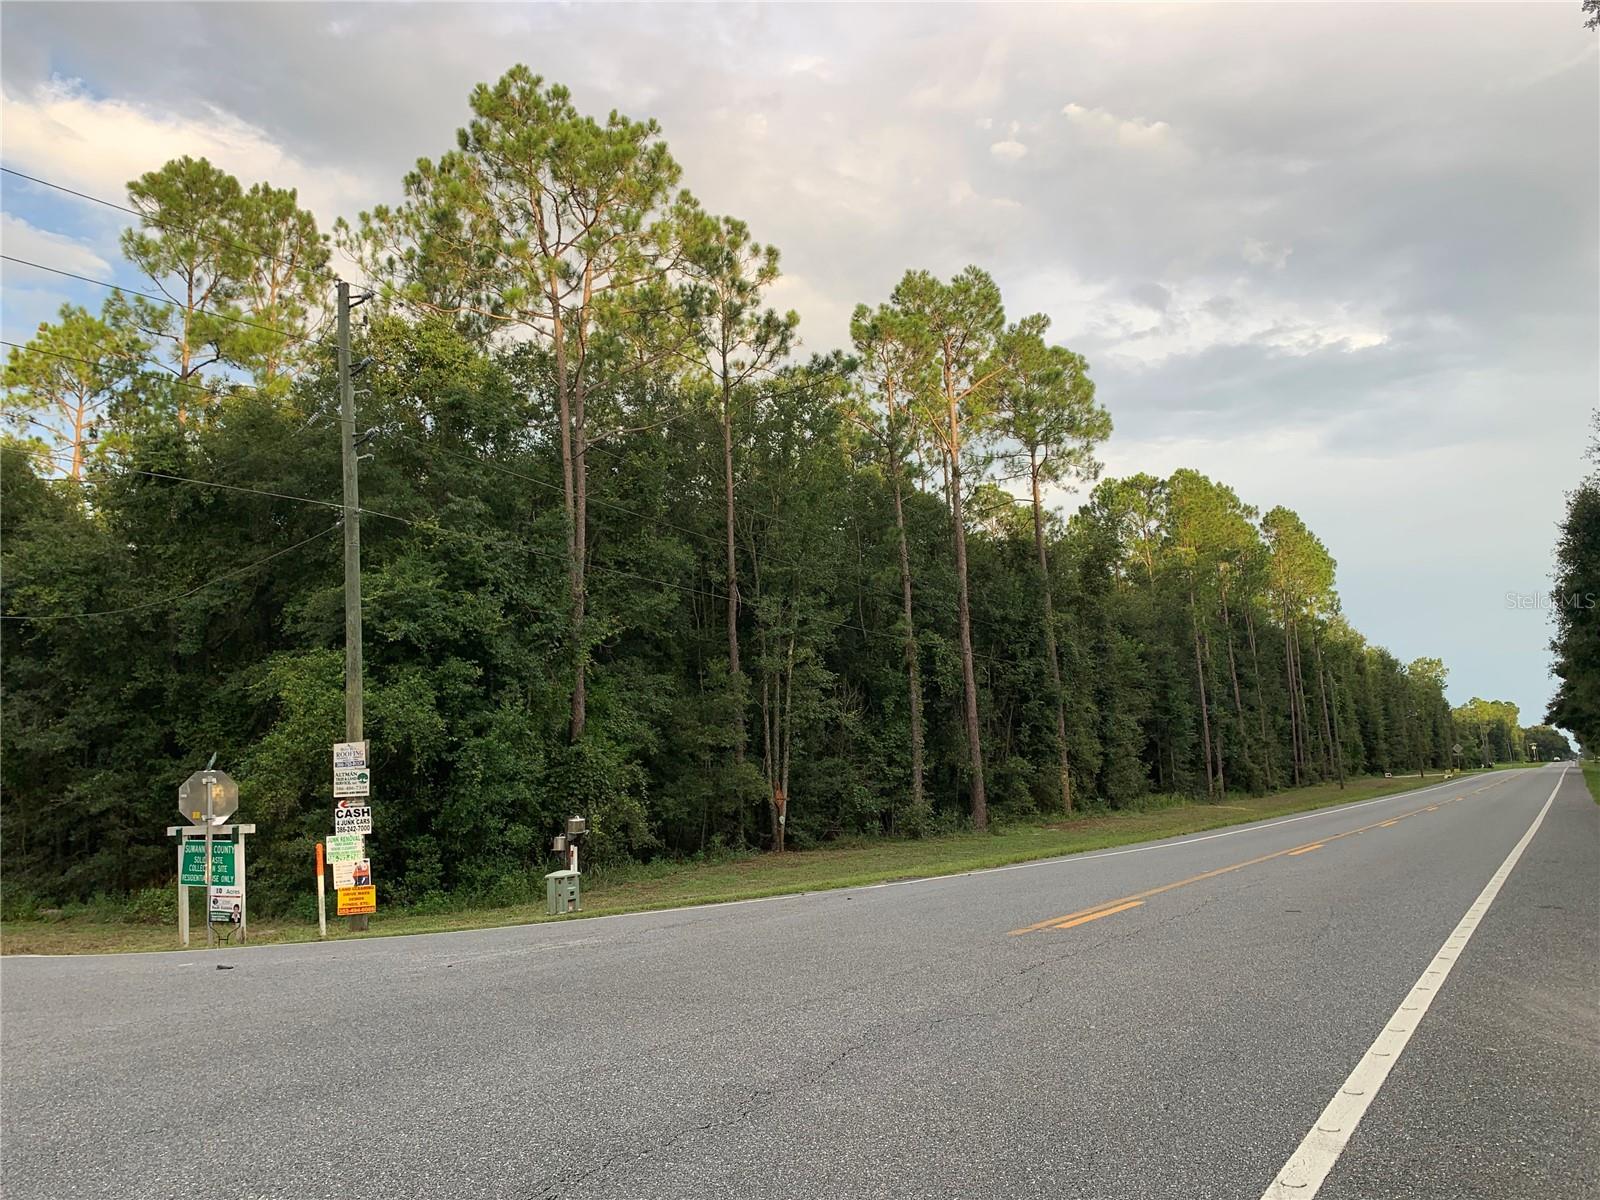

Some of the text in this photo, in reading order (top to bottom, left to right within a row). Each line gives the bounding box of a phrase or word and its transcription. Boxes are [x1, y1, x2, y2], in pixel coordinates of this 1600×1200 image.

[336, 750, 364, 758] ROOFING
[336, 808, 370, 819] CASH
[337, 825, 370, 833] 386-242-7000
[213, 845, 235, 854] COUNTY
[189, 864, 228, 873] COLLECN SITE
[220, 875, 234, 883] ONLY
